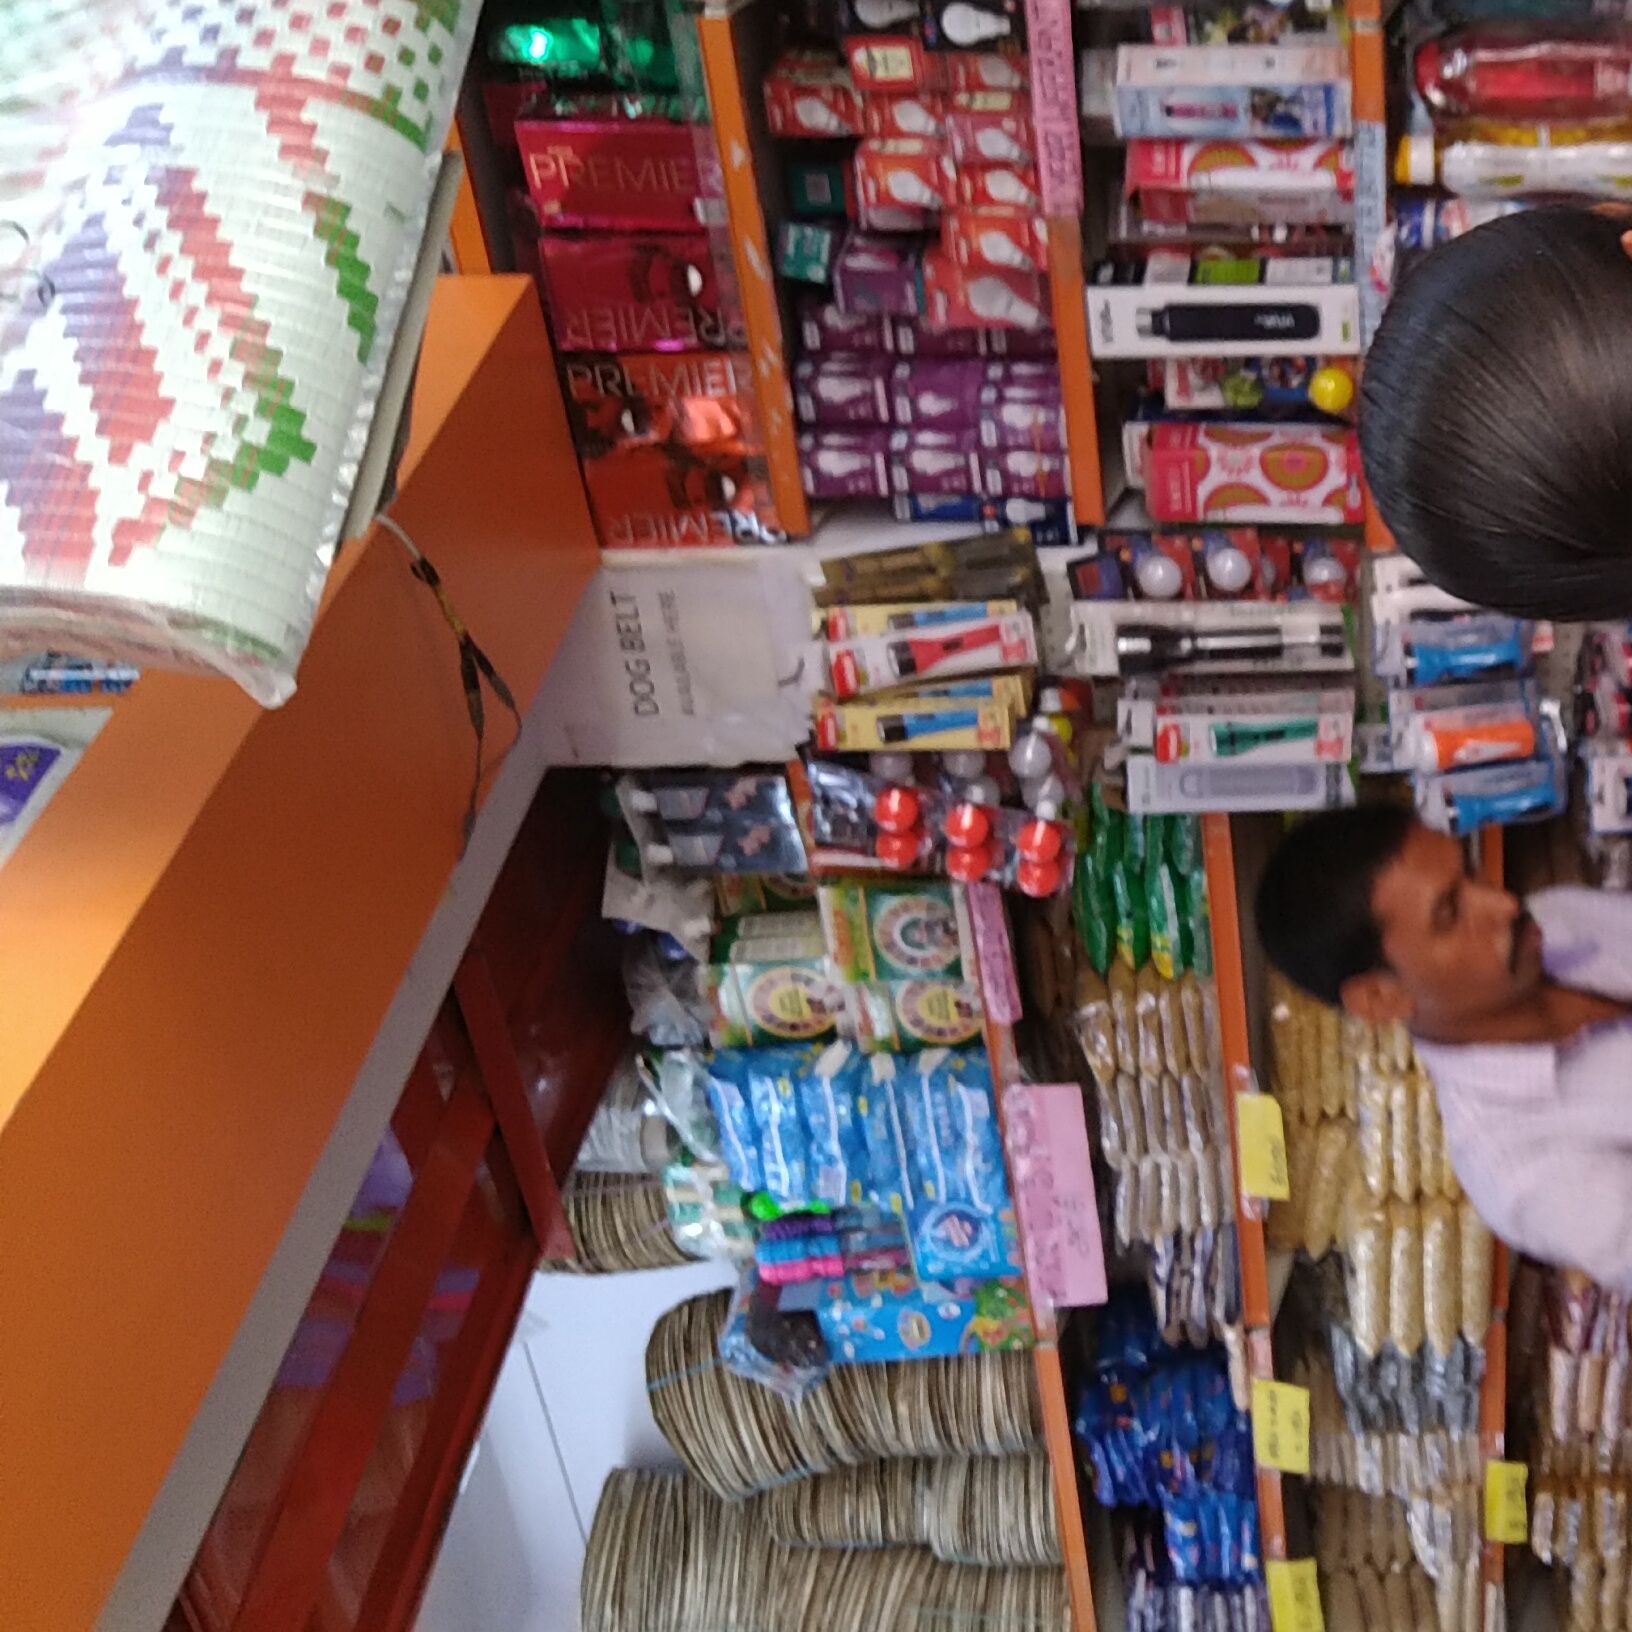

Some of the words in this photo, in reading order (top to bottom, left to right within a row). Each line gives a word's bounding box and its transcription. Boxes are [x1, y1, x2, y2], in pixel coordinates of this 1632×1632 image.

[529, 150, 721, 193] PREMIER
[566, 304, 747, 348] PREMIER
[566, 356, 751, 397] PREMIER
[609, 591, 646, 653] BELT
[625, 659, 659, 716] DOG
